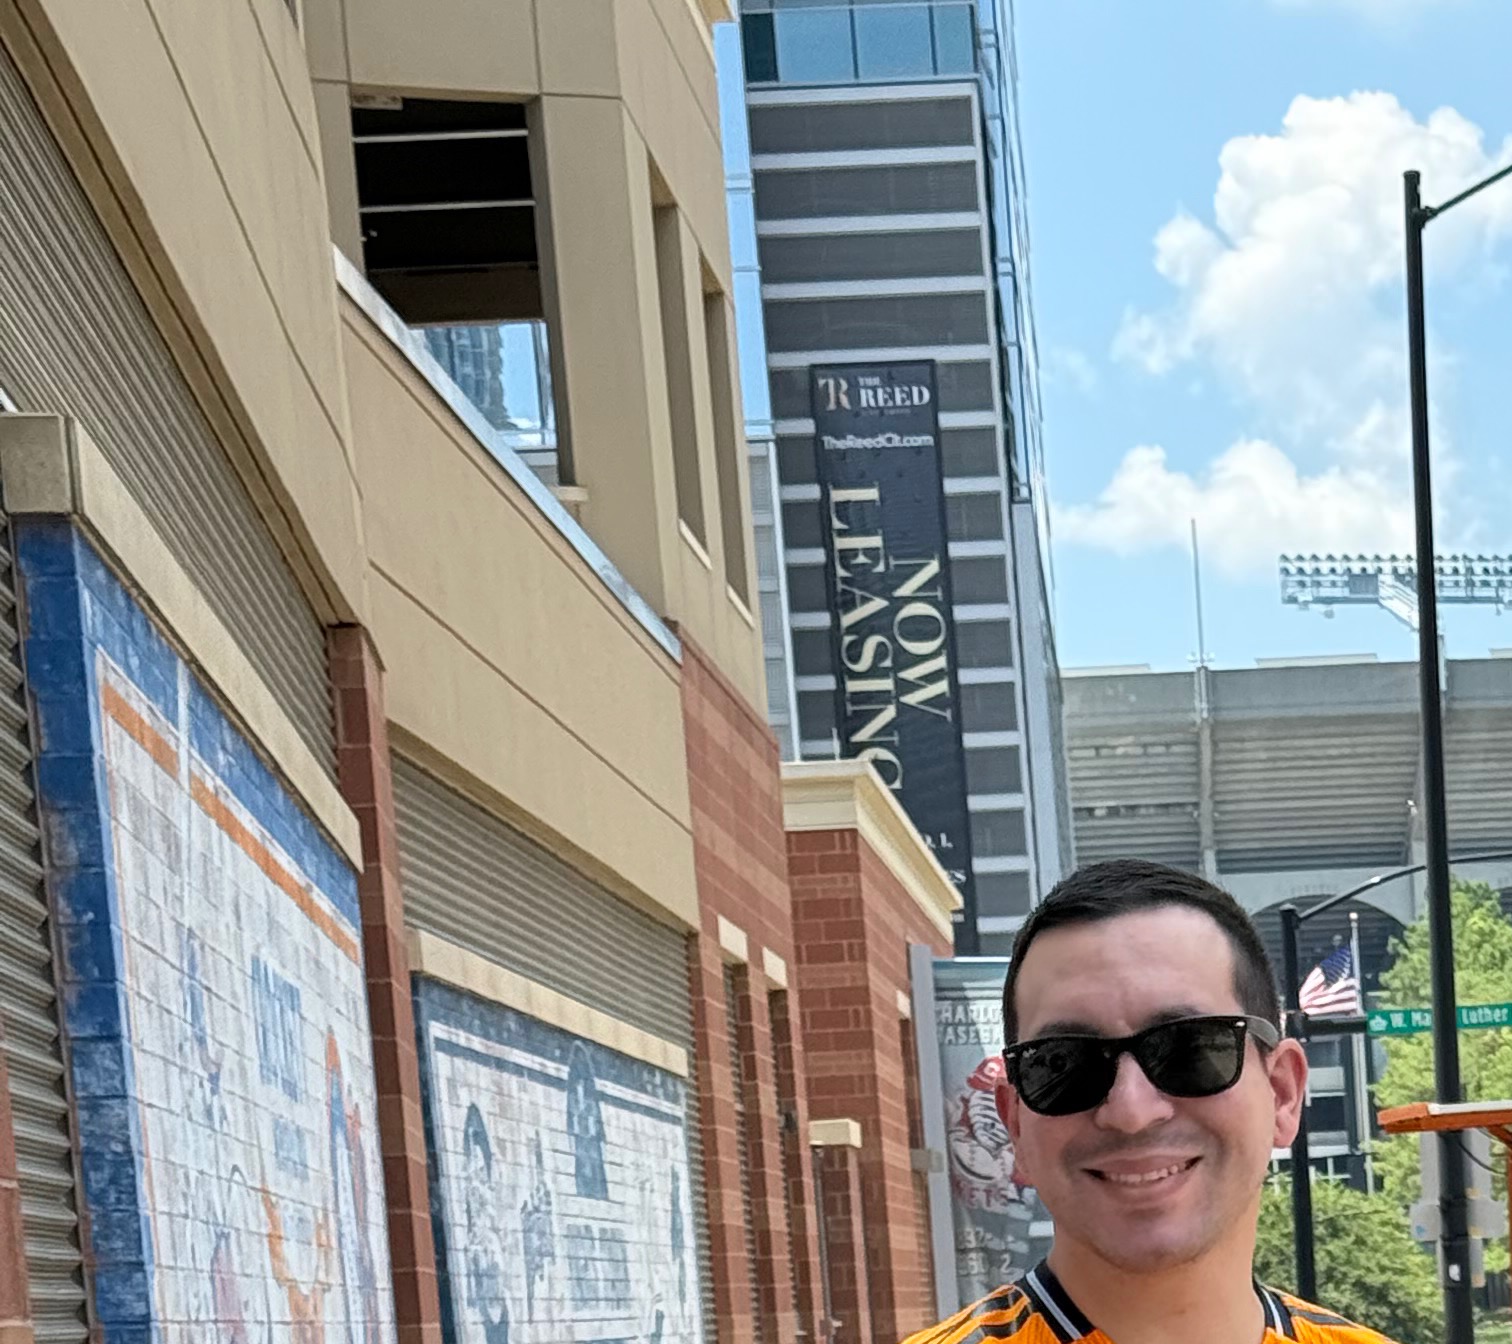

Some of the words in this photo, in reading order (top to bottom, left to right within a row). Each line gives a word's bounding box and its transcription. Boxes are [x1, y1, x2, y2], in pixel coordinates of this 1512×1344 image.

[859, 384, 931, 409] REED
[892, 556, 953, 722] NOW
[1461, 1006, 1508, 1025] Luther
